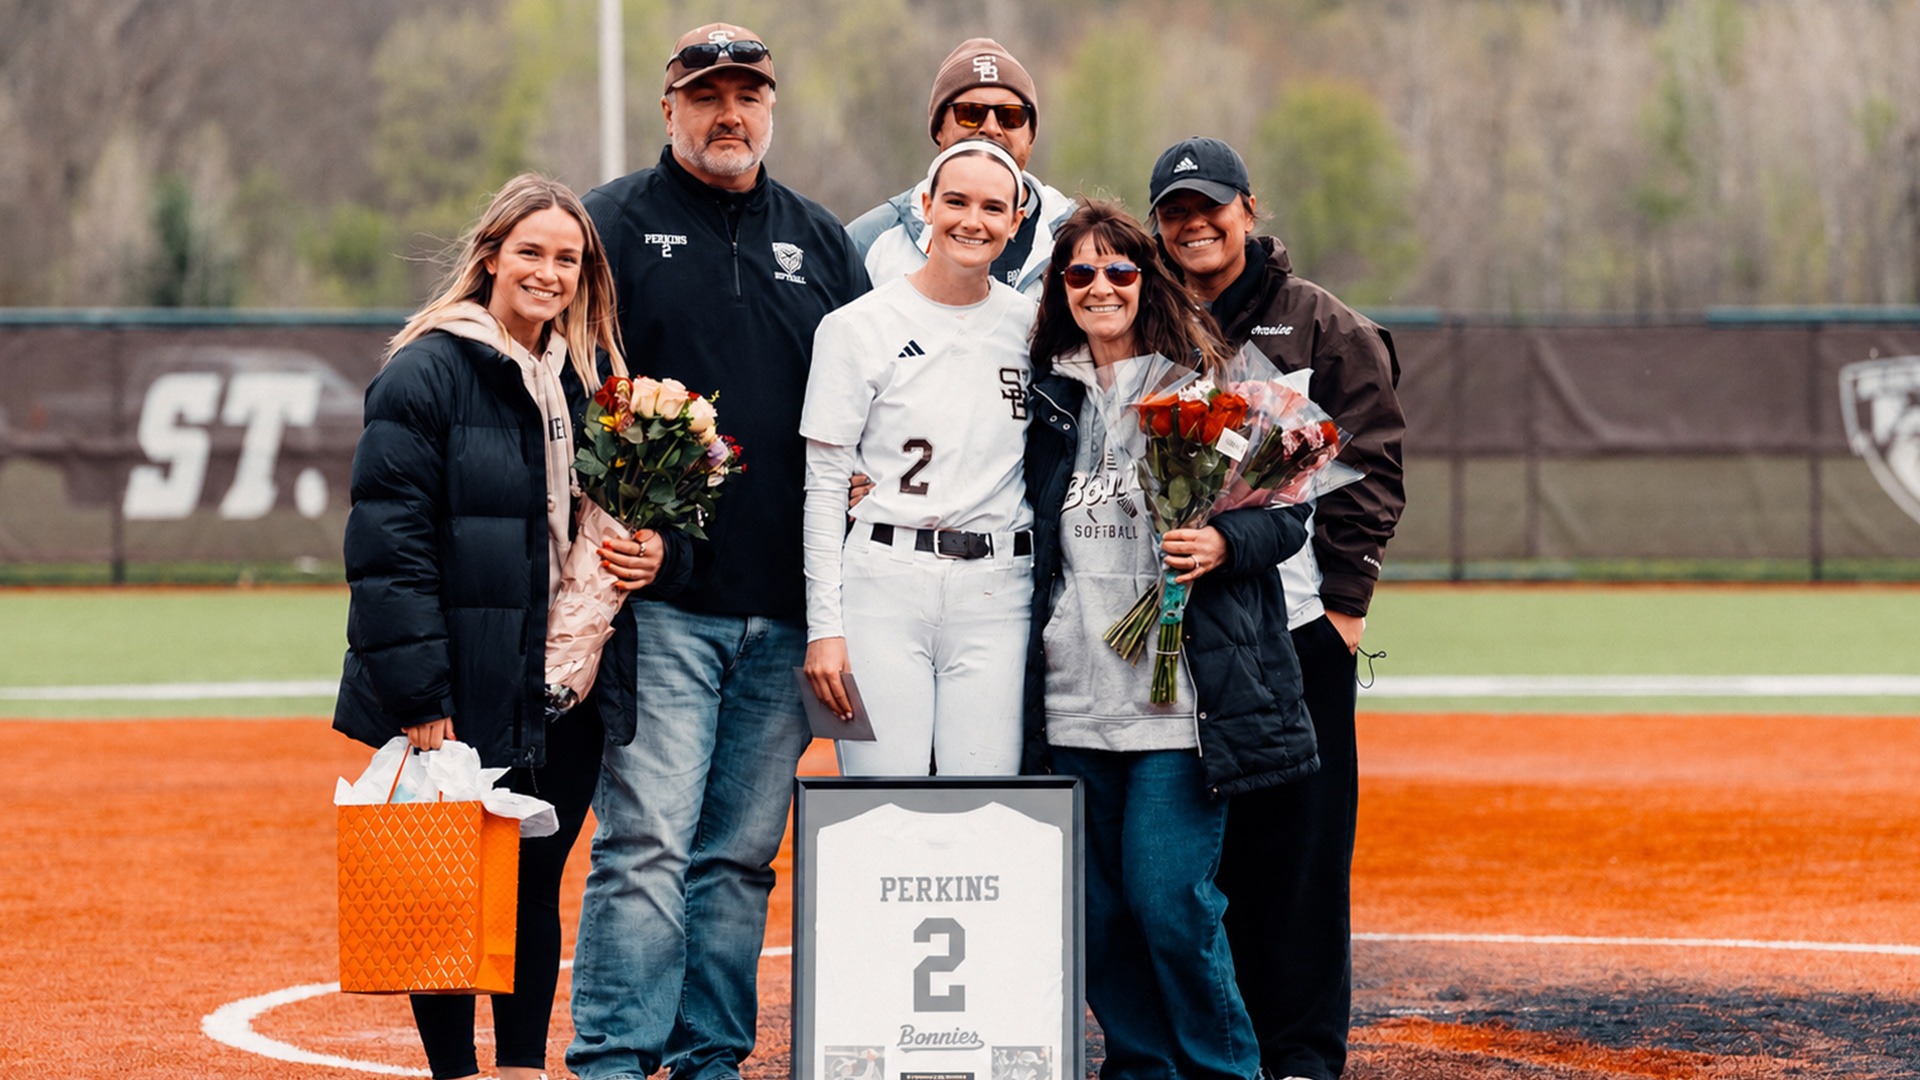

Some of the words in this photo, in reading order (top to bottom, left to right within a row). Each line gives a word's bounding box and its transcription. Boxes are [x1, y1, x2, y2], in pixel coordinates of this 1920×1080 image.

[973, 56, 998, 82] SB
[644, 234, 688, 245] PERKINS
[661, 244, 673, 258] 2
[121, 372, 328, 520] ST.
[899, 438, 933, 496] 2
[1074, 524, 1139, 539] SOFTBALL
[879, 875, 1000, 902] PERKINS
[913, 917, 966, 1013] 2
[896, 1024, 985, 1054] Bonnies
